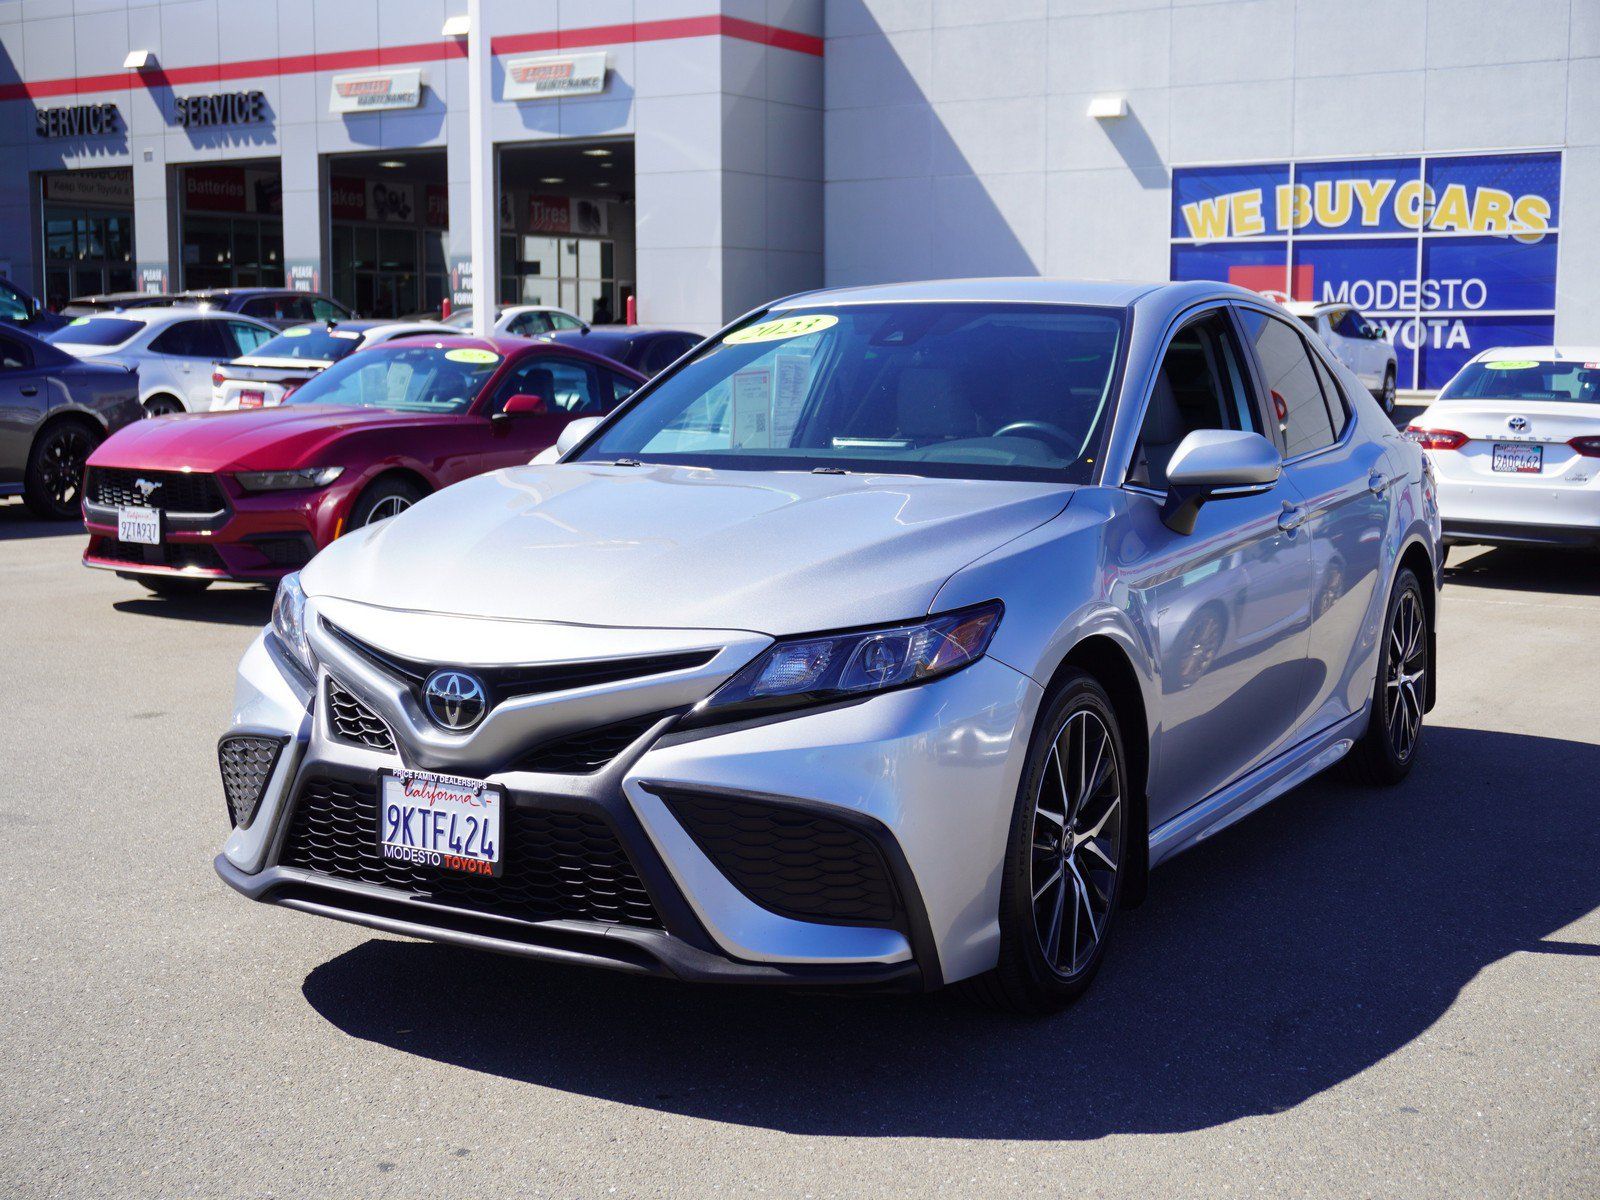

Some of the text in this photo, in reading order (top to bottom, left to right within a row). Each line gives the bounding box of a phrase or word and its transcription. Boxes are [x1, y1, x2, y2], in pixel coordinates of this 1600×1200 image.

[36, 104, 117, 138] SERVICE
[174, 91, 264, 127] SERVICE
[187, 177, 244, 197] Batteries
[333, 188, 364, 207] akes
[530, 201, 568, 224] Tires
[1181, 179, 1551, 245] WE BUY CARS
[1323, 277, 1488, 310] MODESTO
[1365, 319, 1471, 350] YOTA
[121, 521, 157, 540] 9ZTA937
[392, 768, 488, 790] PRICE FAMILY DEALERSHIPS
[404, 778, 473, 807] California
[386, 804, 494, 860] 9KTF424
[384, 844, 494, 877] MODESTO TOYOTA
